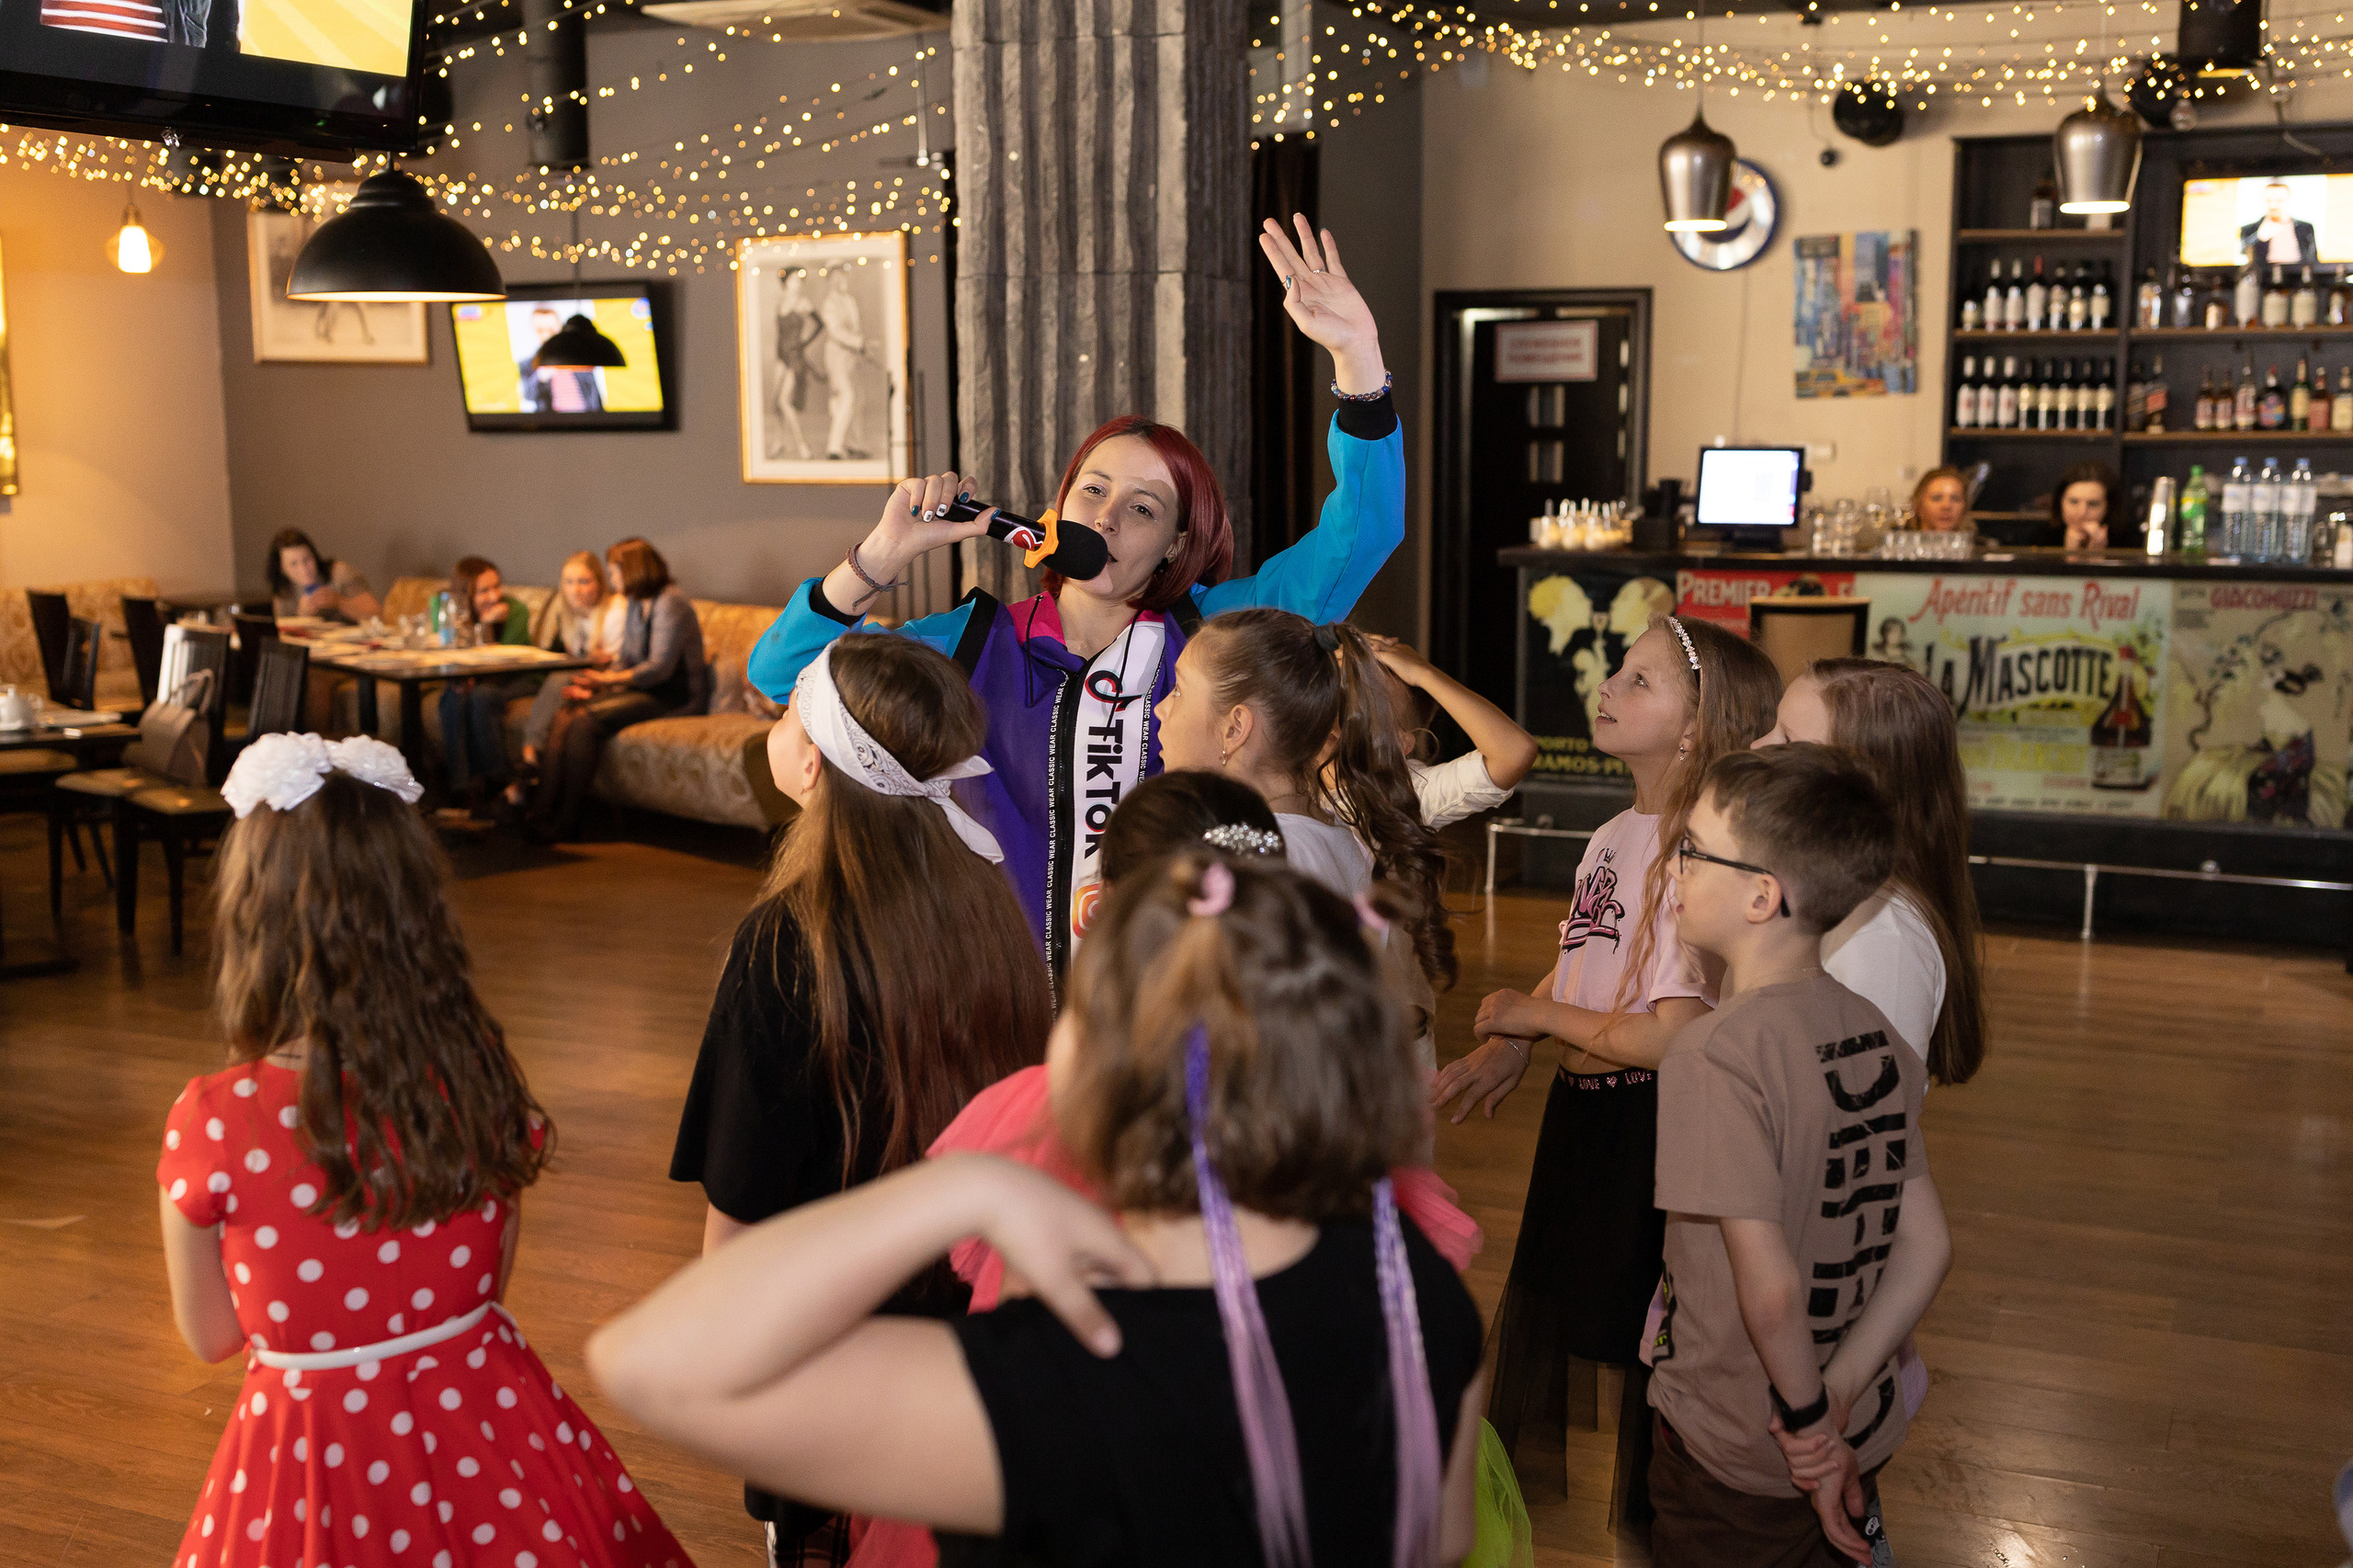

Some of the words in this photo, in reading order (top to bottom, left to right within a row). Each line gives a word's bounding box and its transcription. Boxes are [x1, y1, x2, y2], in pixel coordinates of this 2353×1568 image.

[1677, 571, 1772, 607] PREMIER
[2018, 590, 2073, 619] sans
[2078, 580, 2141, 631] Rival
[1958, 634, 2112, 721] MASCOTTE
[1054, 687, 1064, 704] WEAR
[1050, 704, 1060, 733] CLASSIC
[1140, 743, 1148, 769] CLASSIC
[1048, 839, 1056, 860] WEAR
[1046, 860, 1054, 888] CLASSIC
[1578, 1077, 1600, 1090] LOVE
[1624, 1071, 1652, 1085] LOVE
